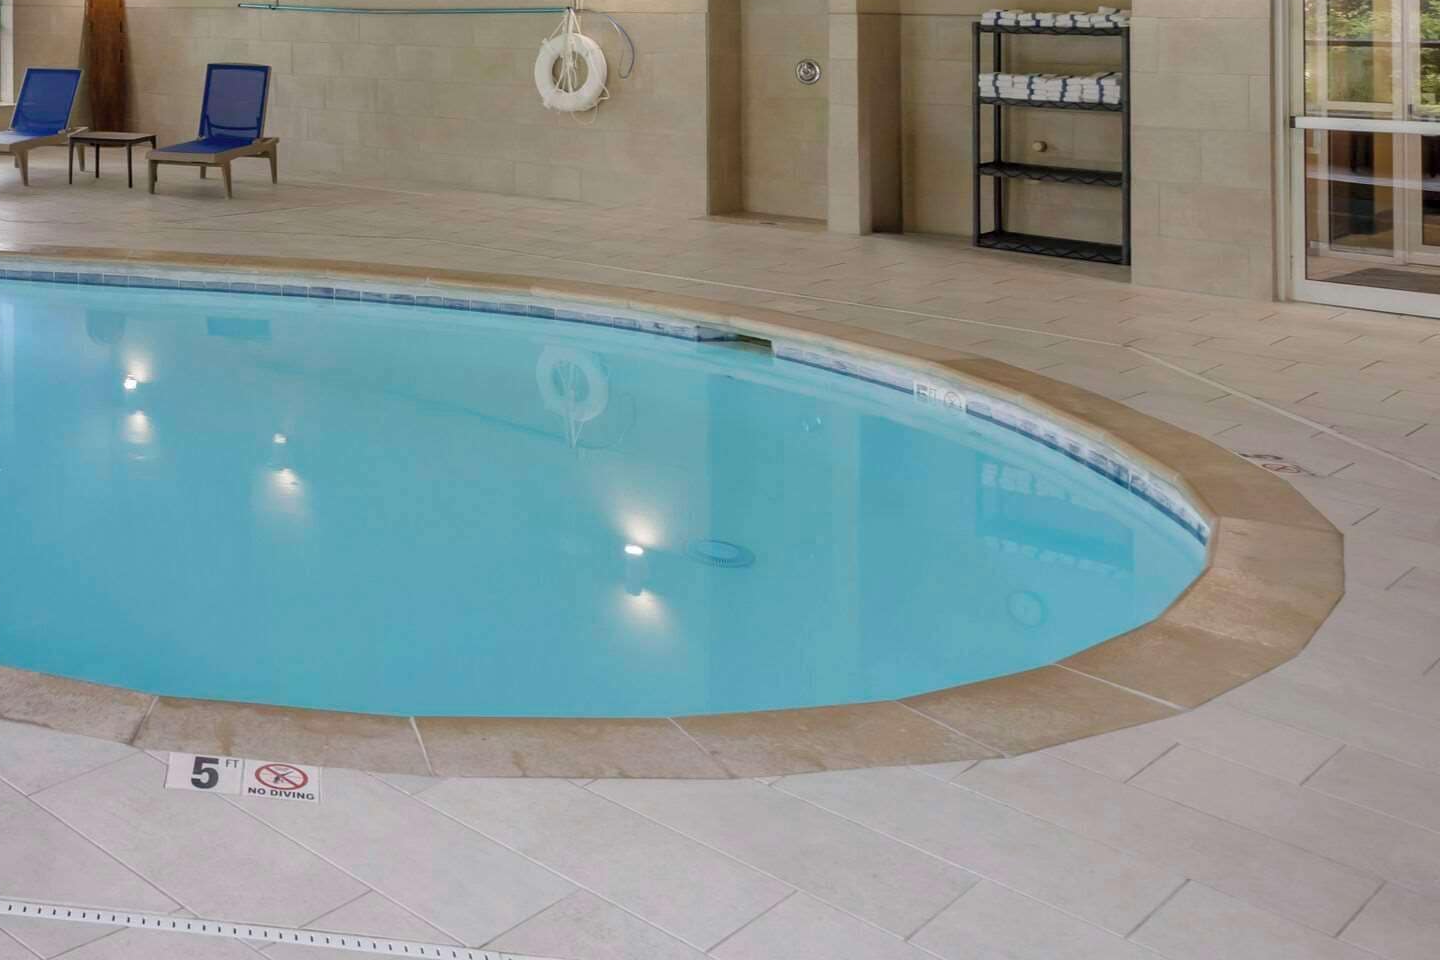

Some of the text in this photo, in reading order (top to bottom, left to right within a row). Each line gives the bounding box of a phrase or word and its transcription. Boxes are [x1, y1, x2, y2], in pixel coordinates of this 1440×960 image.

[190, 756, 239, 789] 5 FT
[247, 787, 315, 800] NO DIVING
